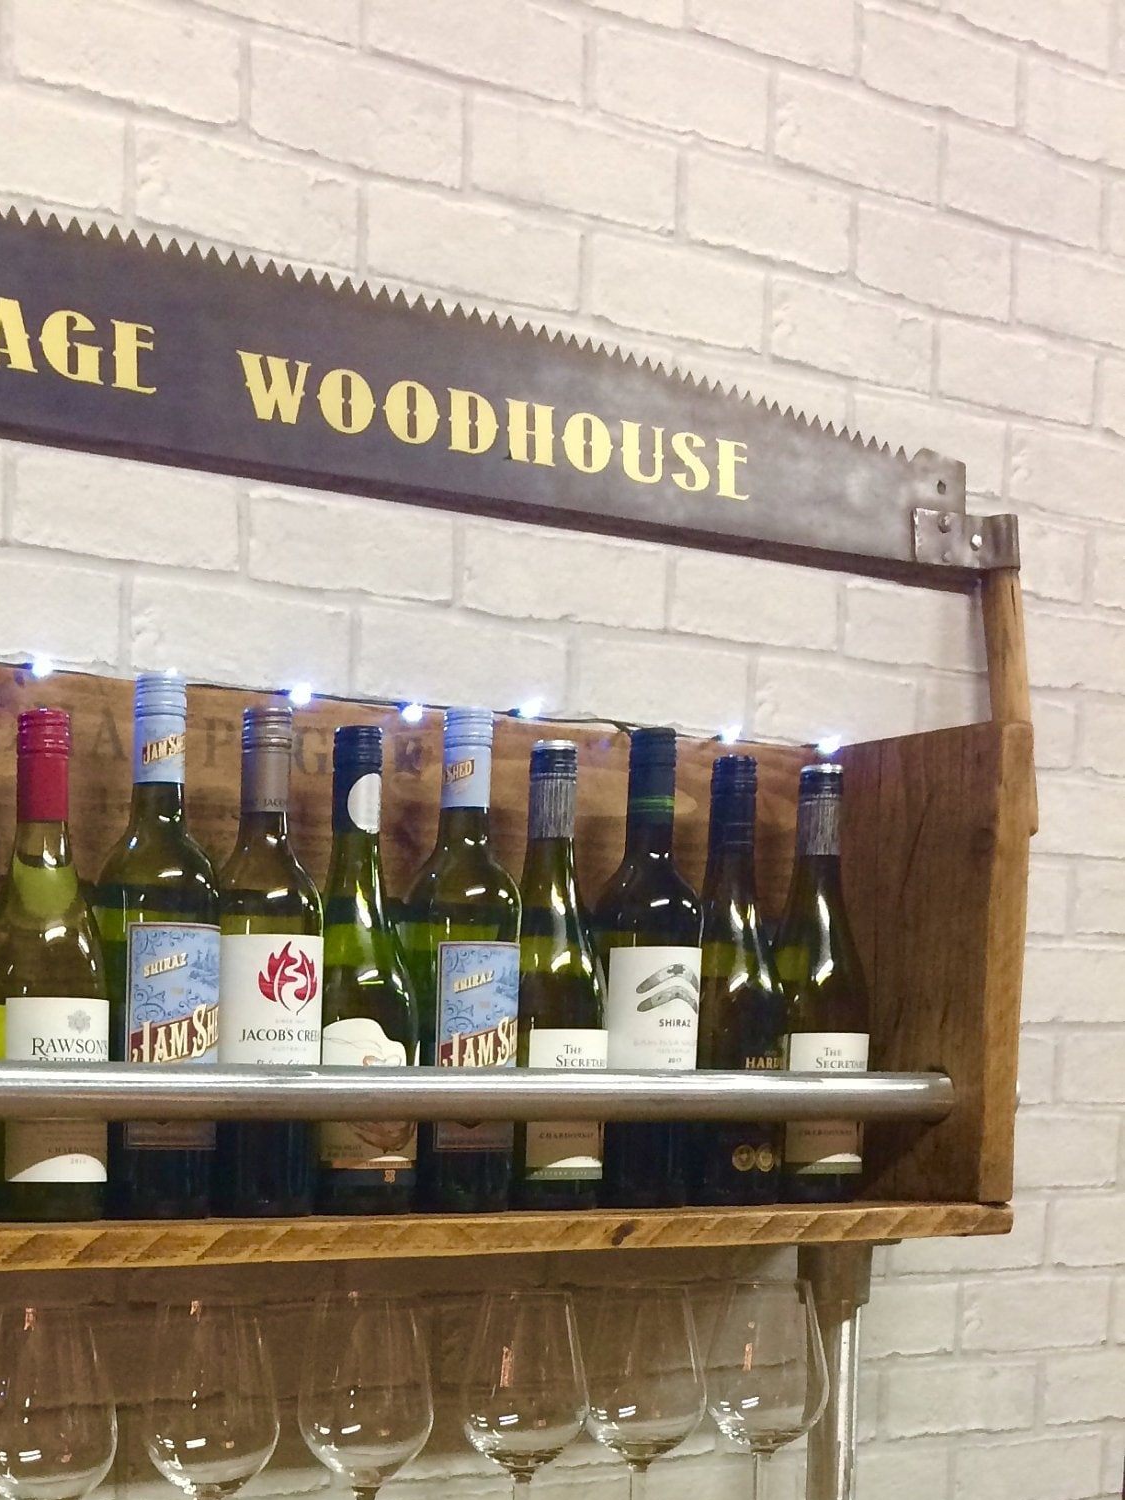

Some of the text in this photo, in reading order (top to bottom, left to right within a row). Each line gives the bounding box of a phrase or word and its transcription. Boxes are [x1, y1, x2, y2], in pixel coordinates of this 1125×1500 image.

[235, 348, 752, 500] WOODHOUSE
[143, 952, 189, 978] SHIRAZ
[454, 970, 495, 994] SHIRAZ
[238, 1026, 294, 1042] JACOB'S
[658, 1018, 692, 1028] SHIRAZ
[131, 1019, 190, 1063] JAM
[442, 1015, 518, 1067] JAM SH
